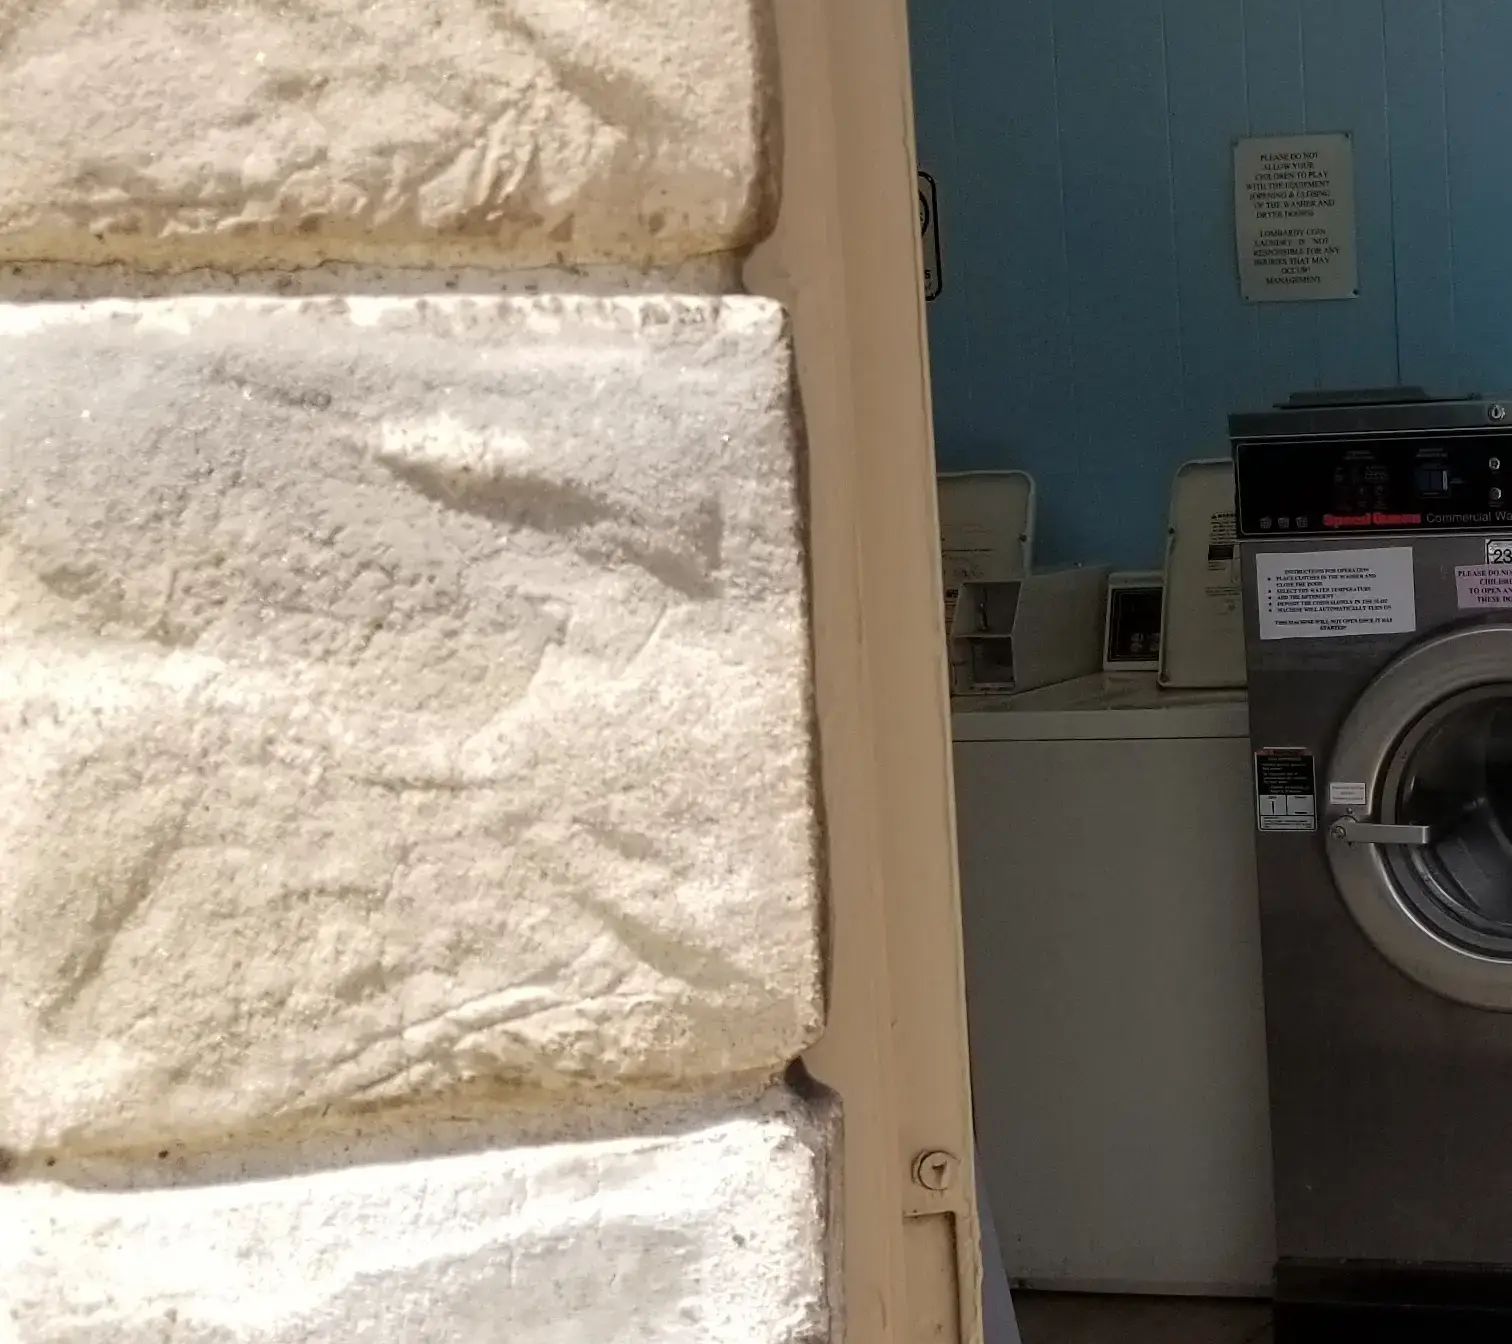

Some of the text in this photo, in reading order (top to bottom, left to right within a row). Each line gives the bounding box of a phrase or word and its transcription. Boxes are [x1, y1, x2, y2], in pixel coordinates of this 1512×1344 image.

[1260, 153, 1289, 161] PLEASE
[1303, 151, 1318, 159] NOT
[1292, 162, 1313, 170] YOUR
[1255, 173, 1294, 181] CHILDREN
[1309, 171, 1328, 179] PLAY
[1269, 182, 1283, 190] THE
[1283, 200, 1316, 208] WASHER
[1318, 199, 1335, 207] AND
[1256, 211, 1283, 219] DRYER
[1260, 229, 1305, 238] LOMBARDY
[1253, 246, 1340, 257] RESPONSIBLE FOR ANY
[1266, 276, 1322, 285] MANAGEMENT
[1426, 511, 1492, 524] Commercial
[1494, 549, 1512, 564] 23
